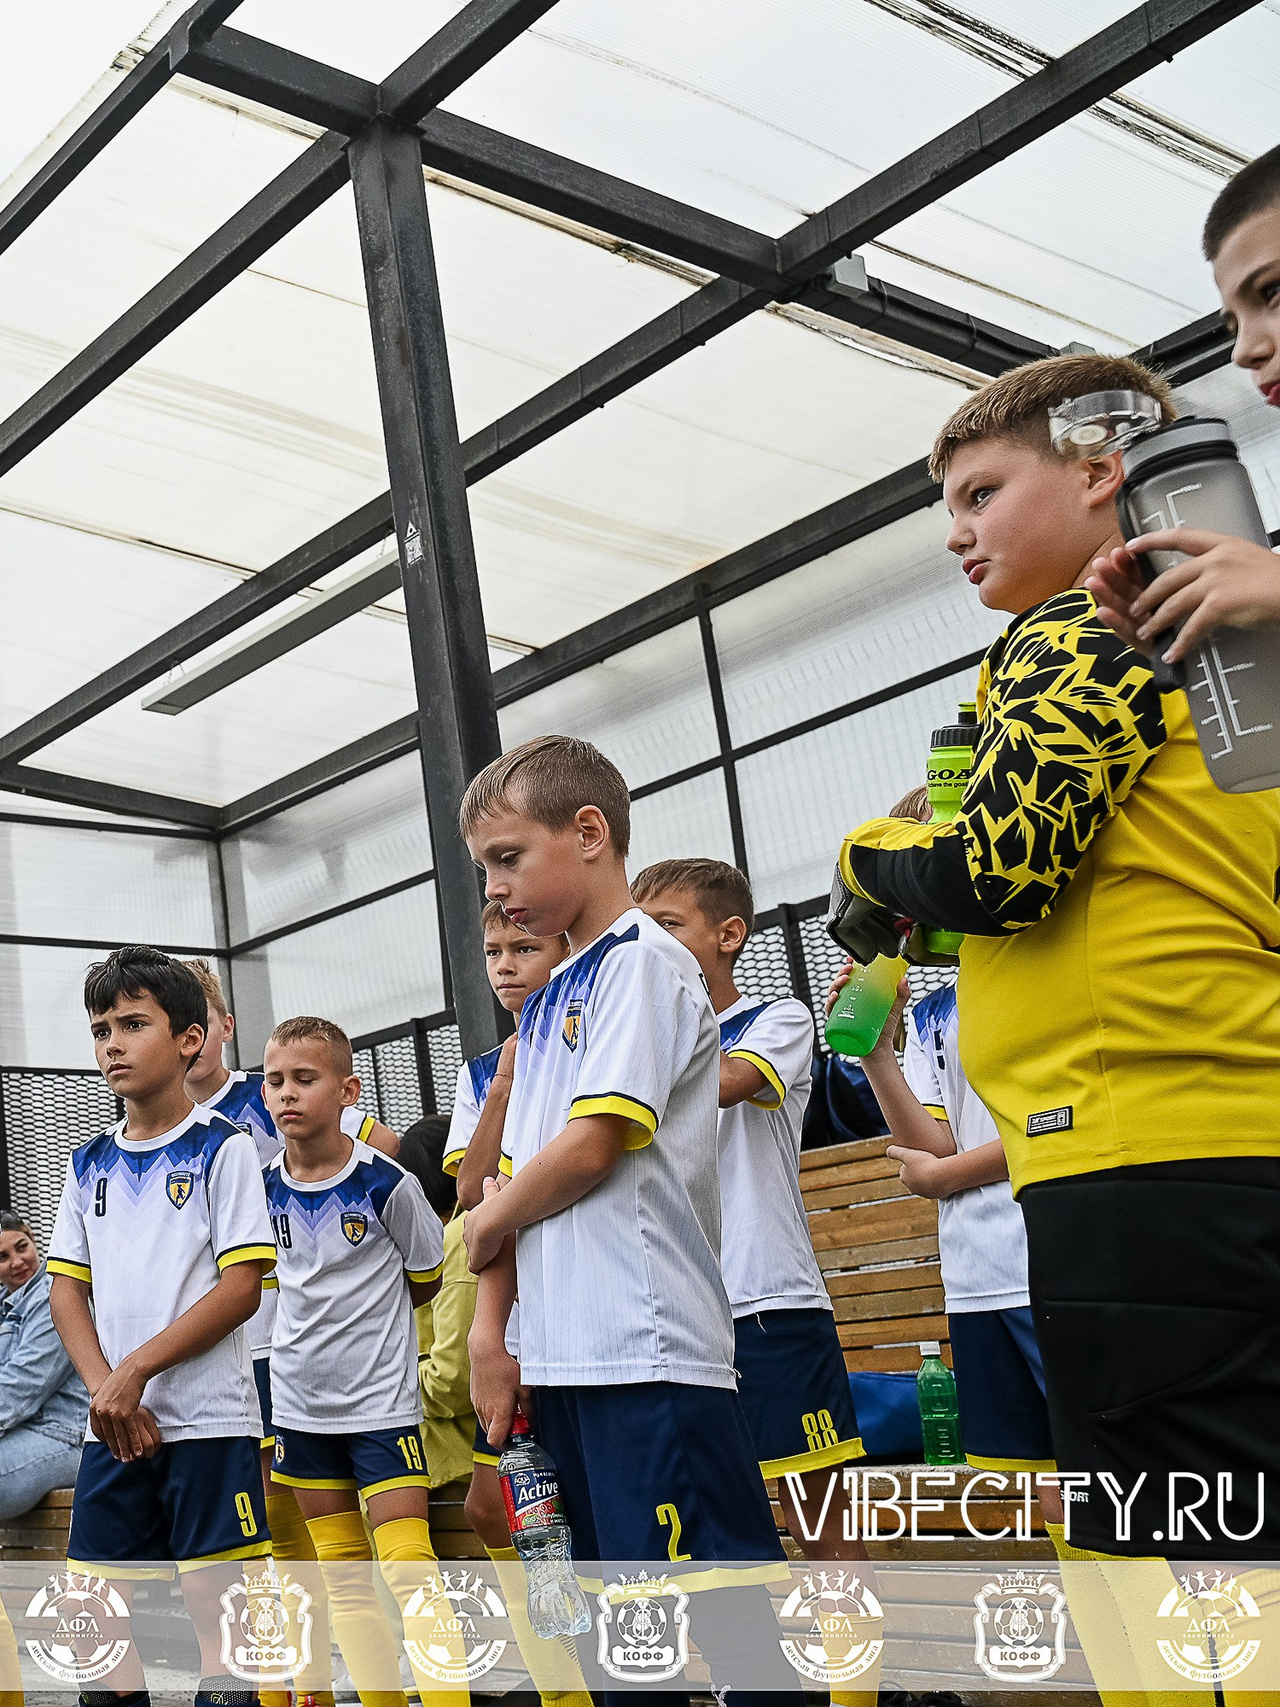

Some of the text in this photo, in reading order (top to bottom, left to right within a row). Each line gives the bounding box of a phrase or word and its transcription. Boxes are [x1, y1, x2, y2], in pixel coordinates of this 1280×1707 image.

[927, 769, 971, 781] GOA
[94, 1177, 109, 1218] 9
[272, 1213, 293, 1250] 19
[801, 1409, 838, 1452] 88
[396, 1435, 423, 1471] 19
[517, 1480, 559, 1505] Active
[1060, 1490, 1090, 1503] SORT
[234, 1491, 258, 1538] 9
[655, 1502, 692, 1564] 2
